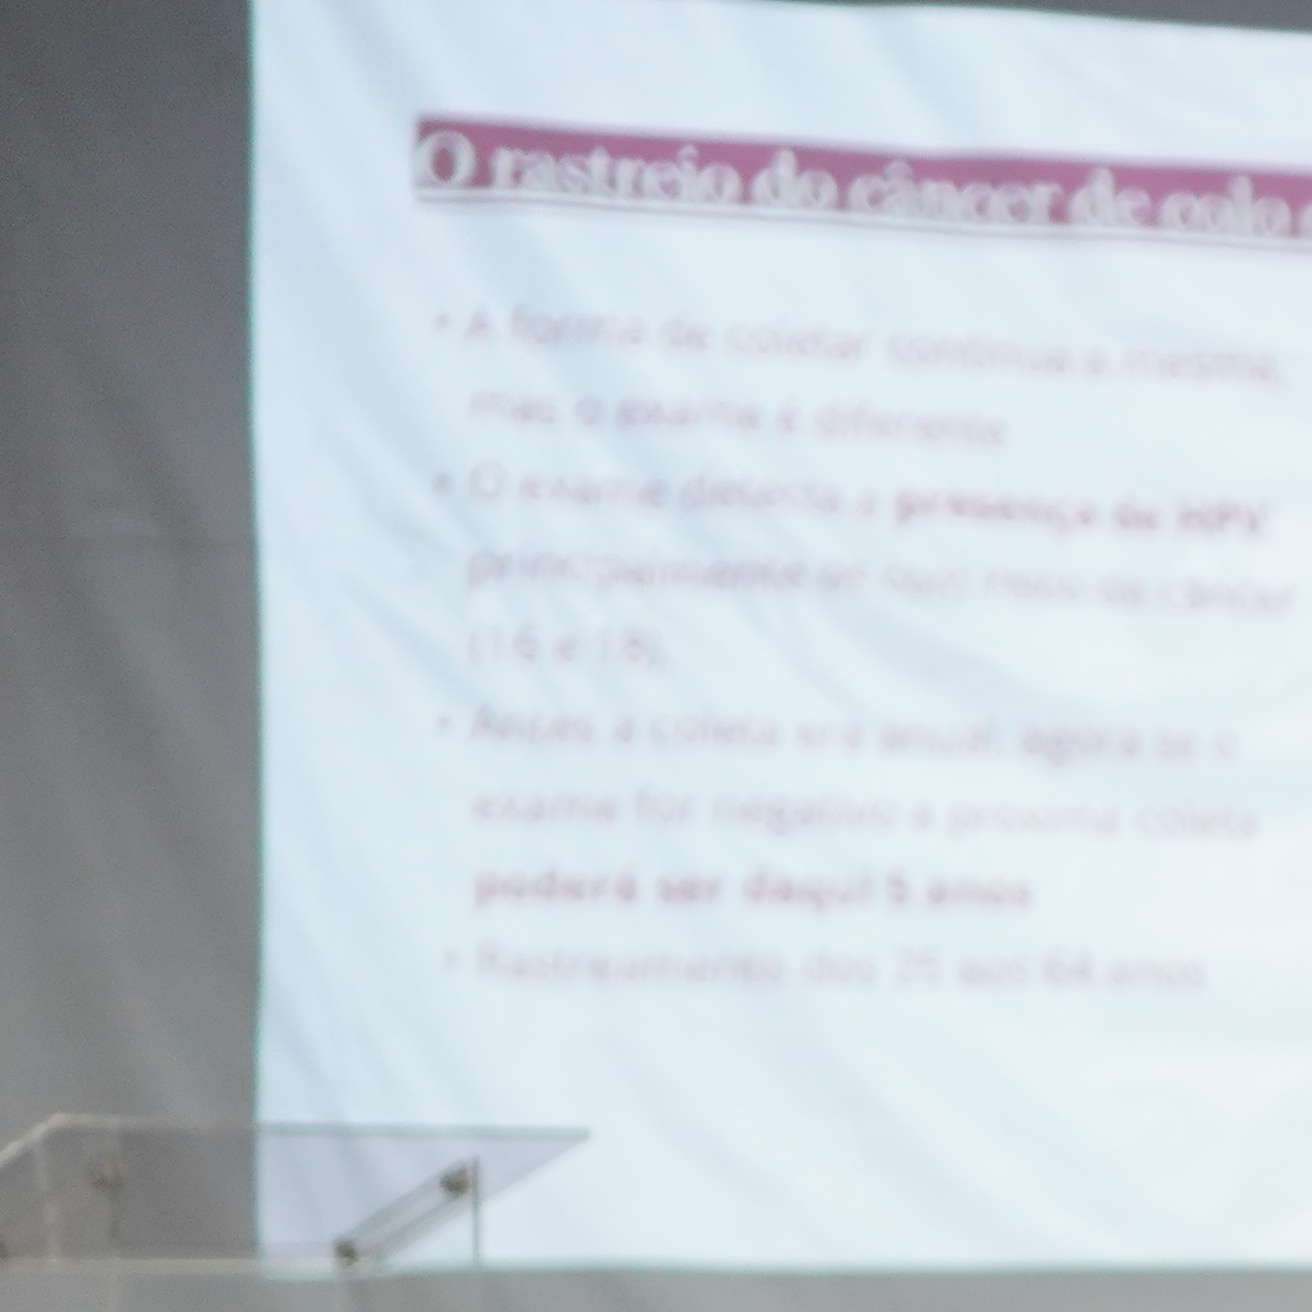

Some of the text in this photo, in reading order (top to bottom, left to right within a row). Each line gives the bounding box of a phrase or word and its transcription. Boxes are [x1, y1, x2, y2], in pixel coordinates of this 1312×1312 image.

[417, 131, 475, 188] O
[493, 143, 741, 203] rastreio
[750, 147, 838, 210] do
[848, 158, 1063, 226] câncer
[1068, 165, 1151, 228] de
[1159, 174, 1290, 240] colo
